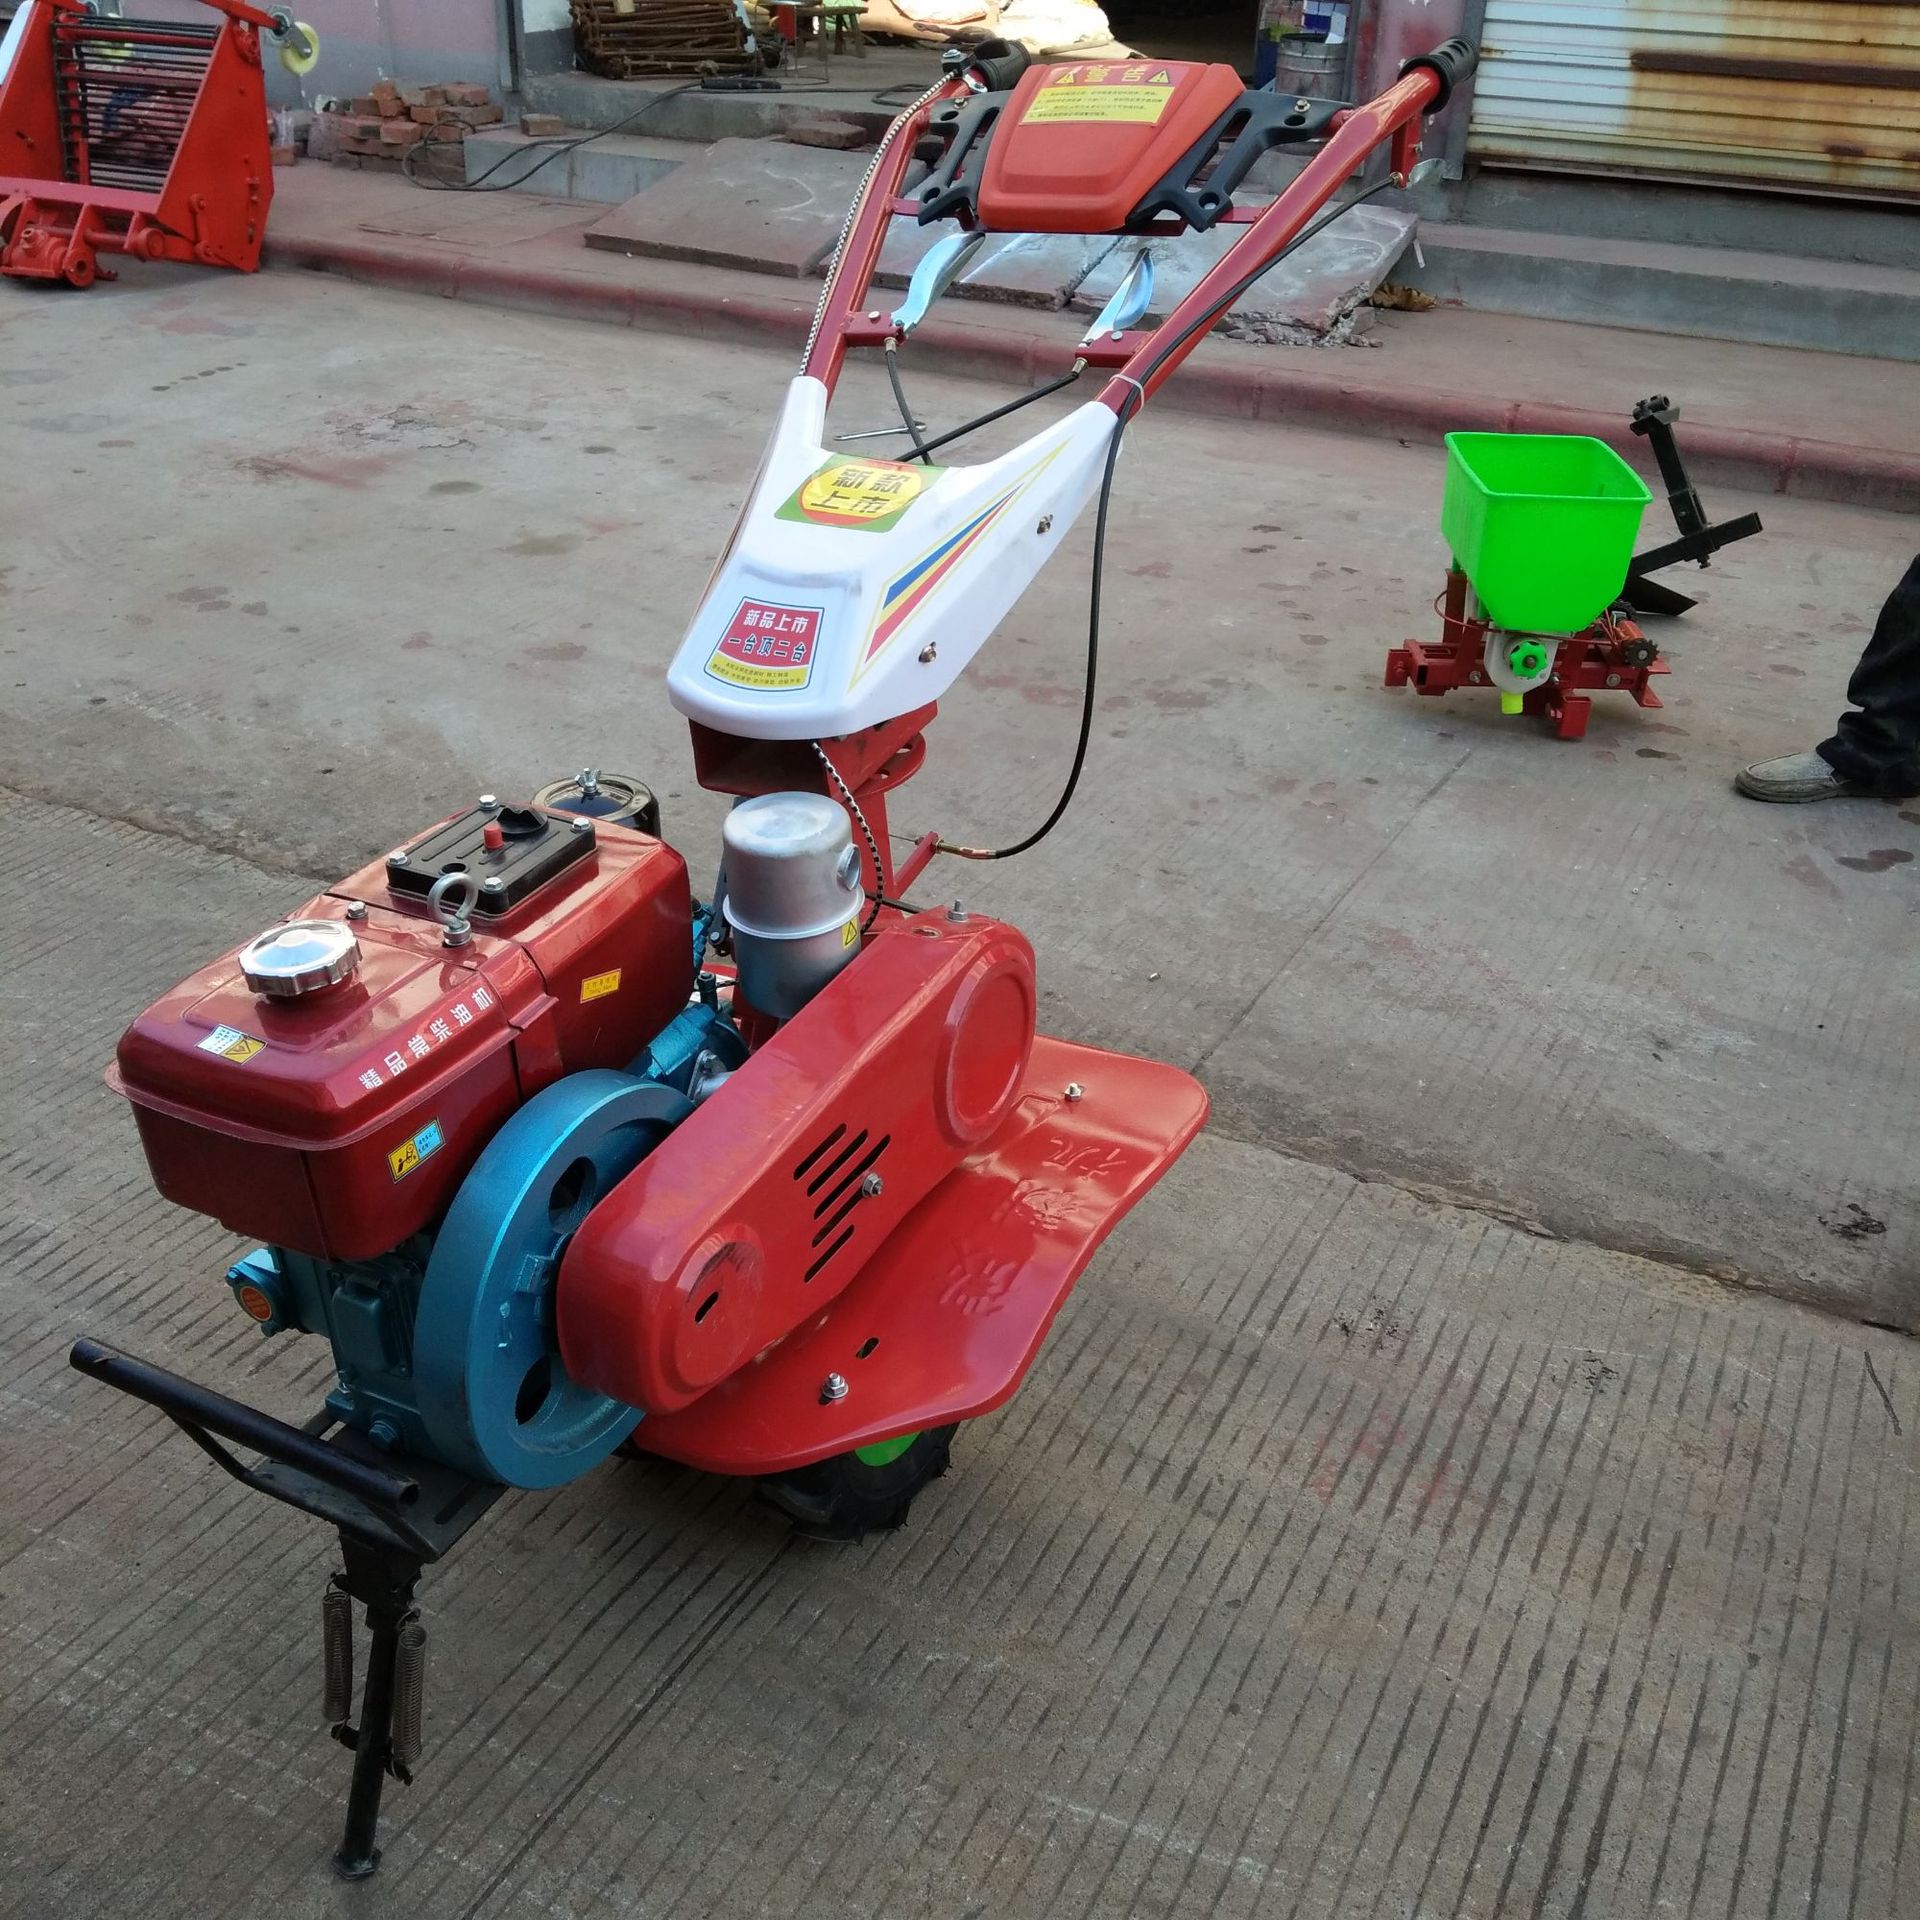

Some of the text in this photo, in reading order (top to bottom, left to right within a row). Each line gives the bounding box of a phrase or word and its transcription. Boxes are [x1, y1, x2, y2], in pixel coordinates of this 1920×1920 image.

[1085, 66, 1146, 83] 警告
[831, 468, 911, 494] 新款
[810, 491, 890, 513] 上市
[743, 609, 809, 634] 新品上市
[728, 633, 807, 664] 一台顶二台
[358, 987, 494, 1090] 精品常柴油机
